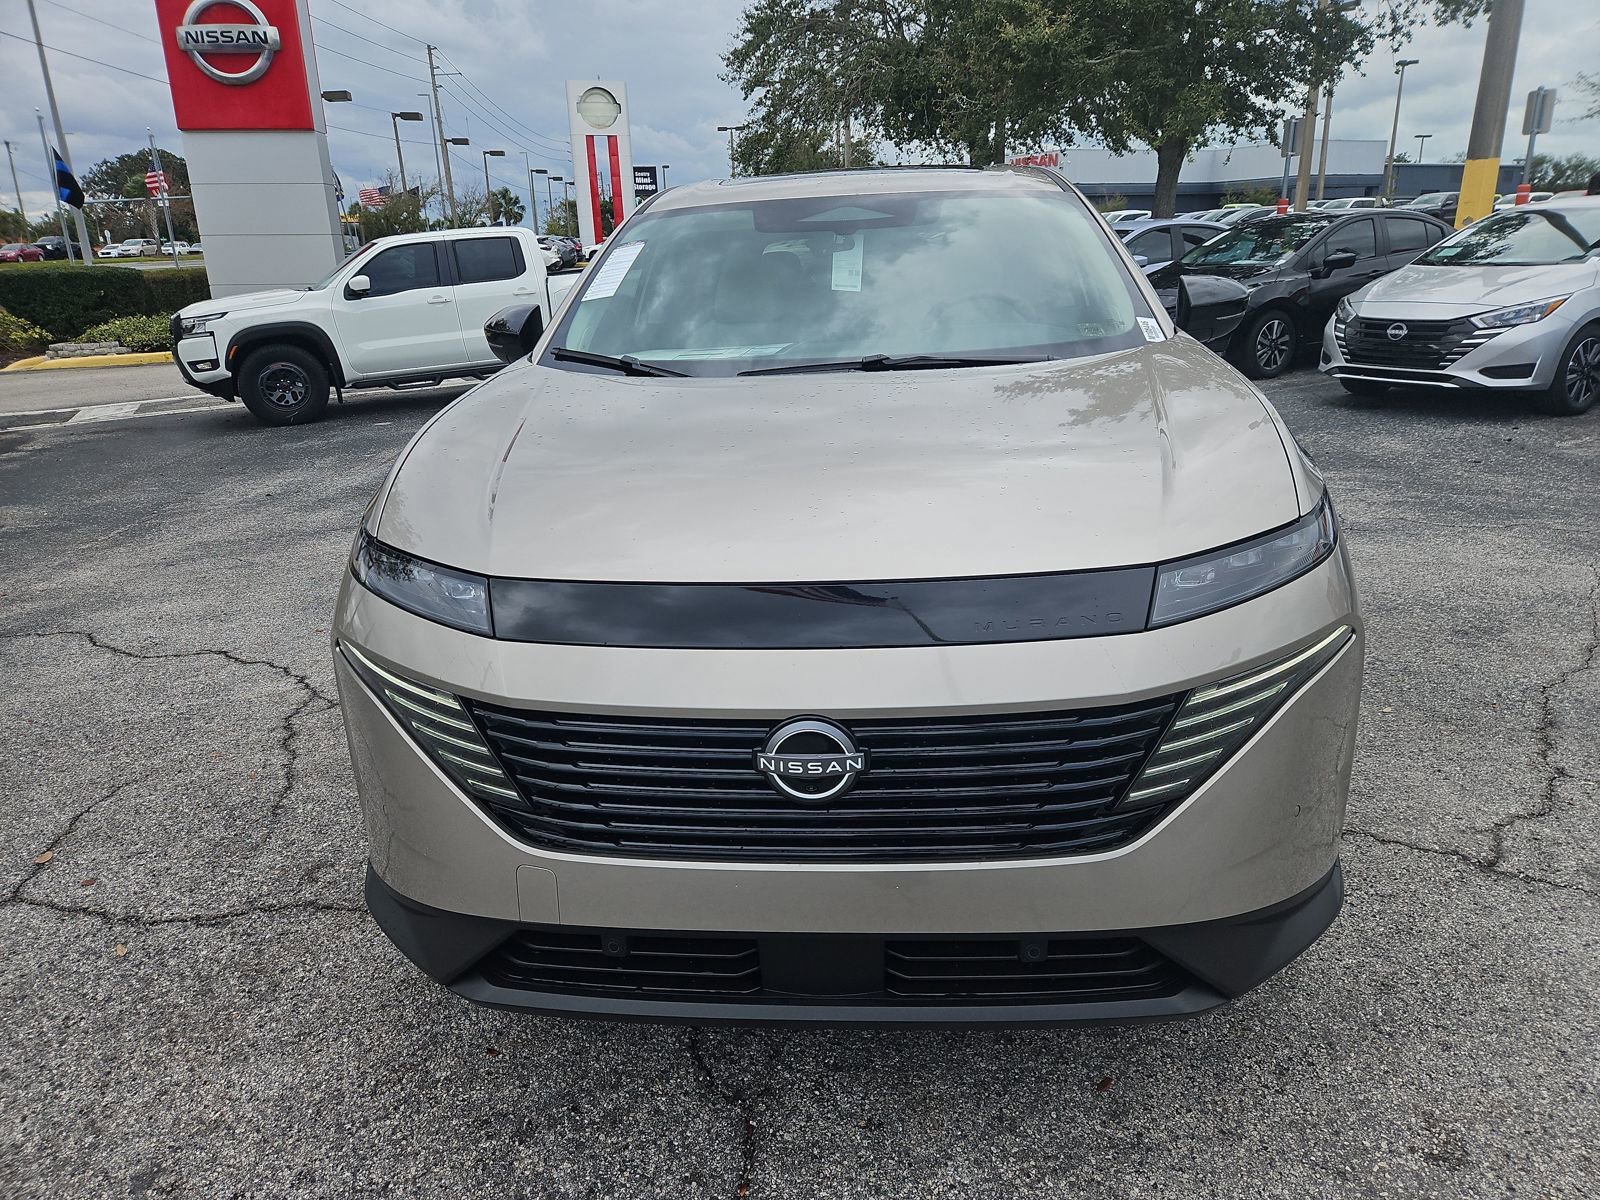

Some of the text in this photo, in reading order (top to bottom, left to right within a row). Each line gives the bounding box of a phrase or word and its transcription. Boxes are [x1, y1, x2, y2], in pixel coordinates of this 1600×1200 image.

[184, 30, 269, 45] NISSAN
[974, 612, 1124, 632] MURANO
[760, 757, 862, 774] NISSAN
